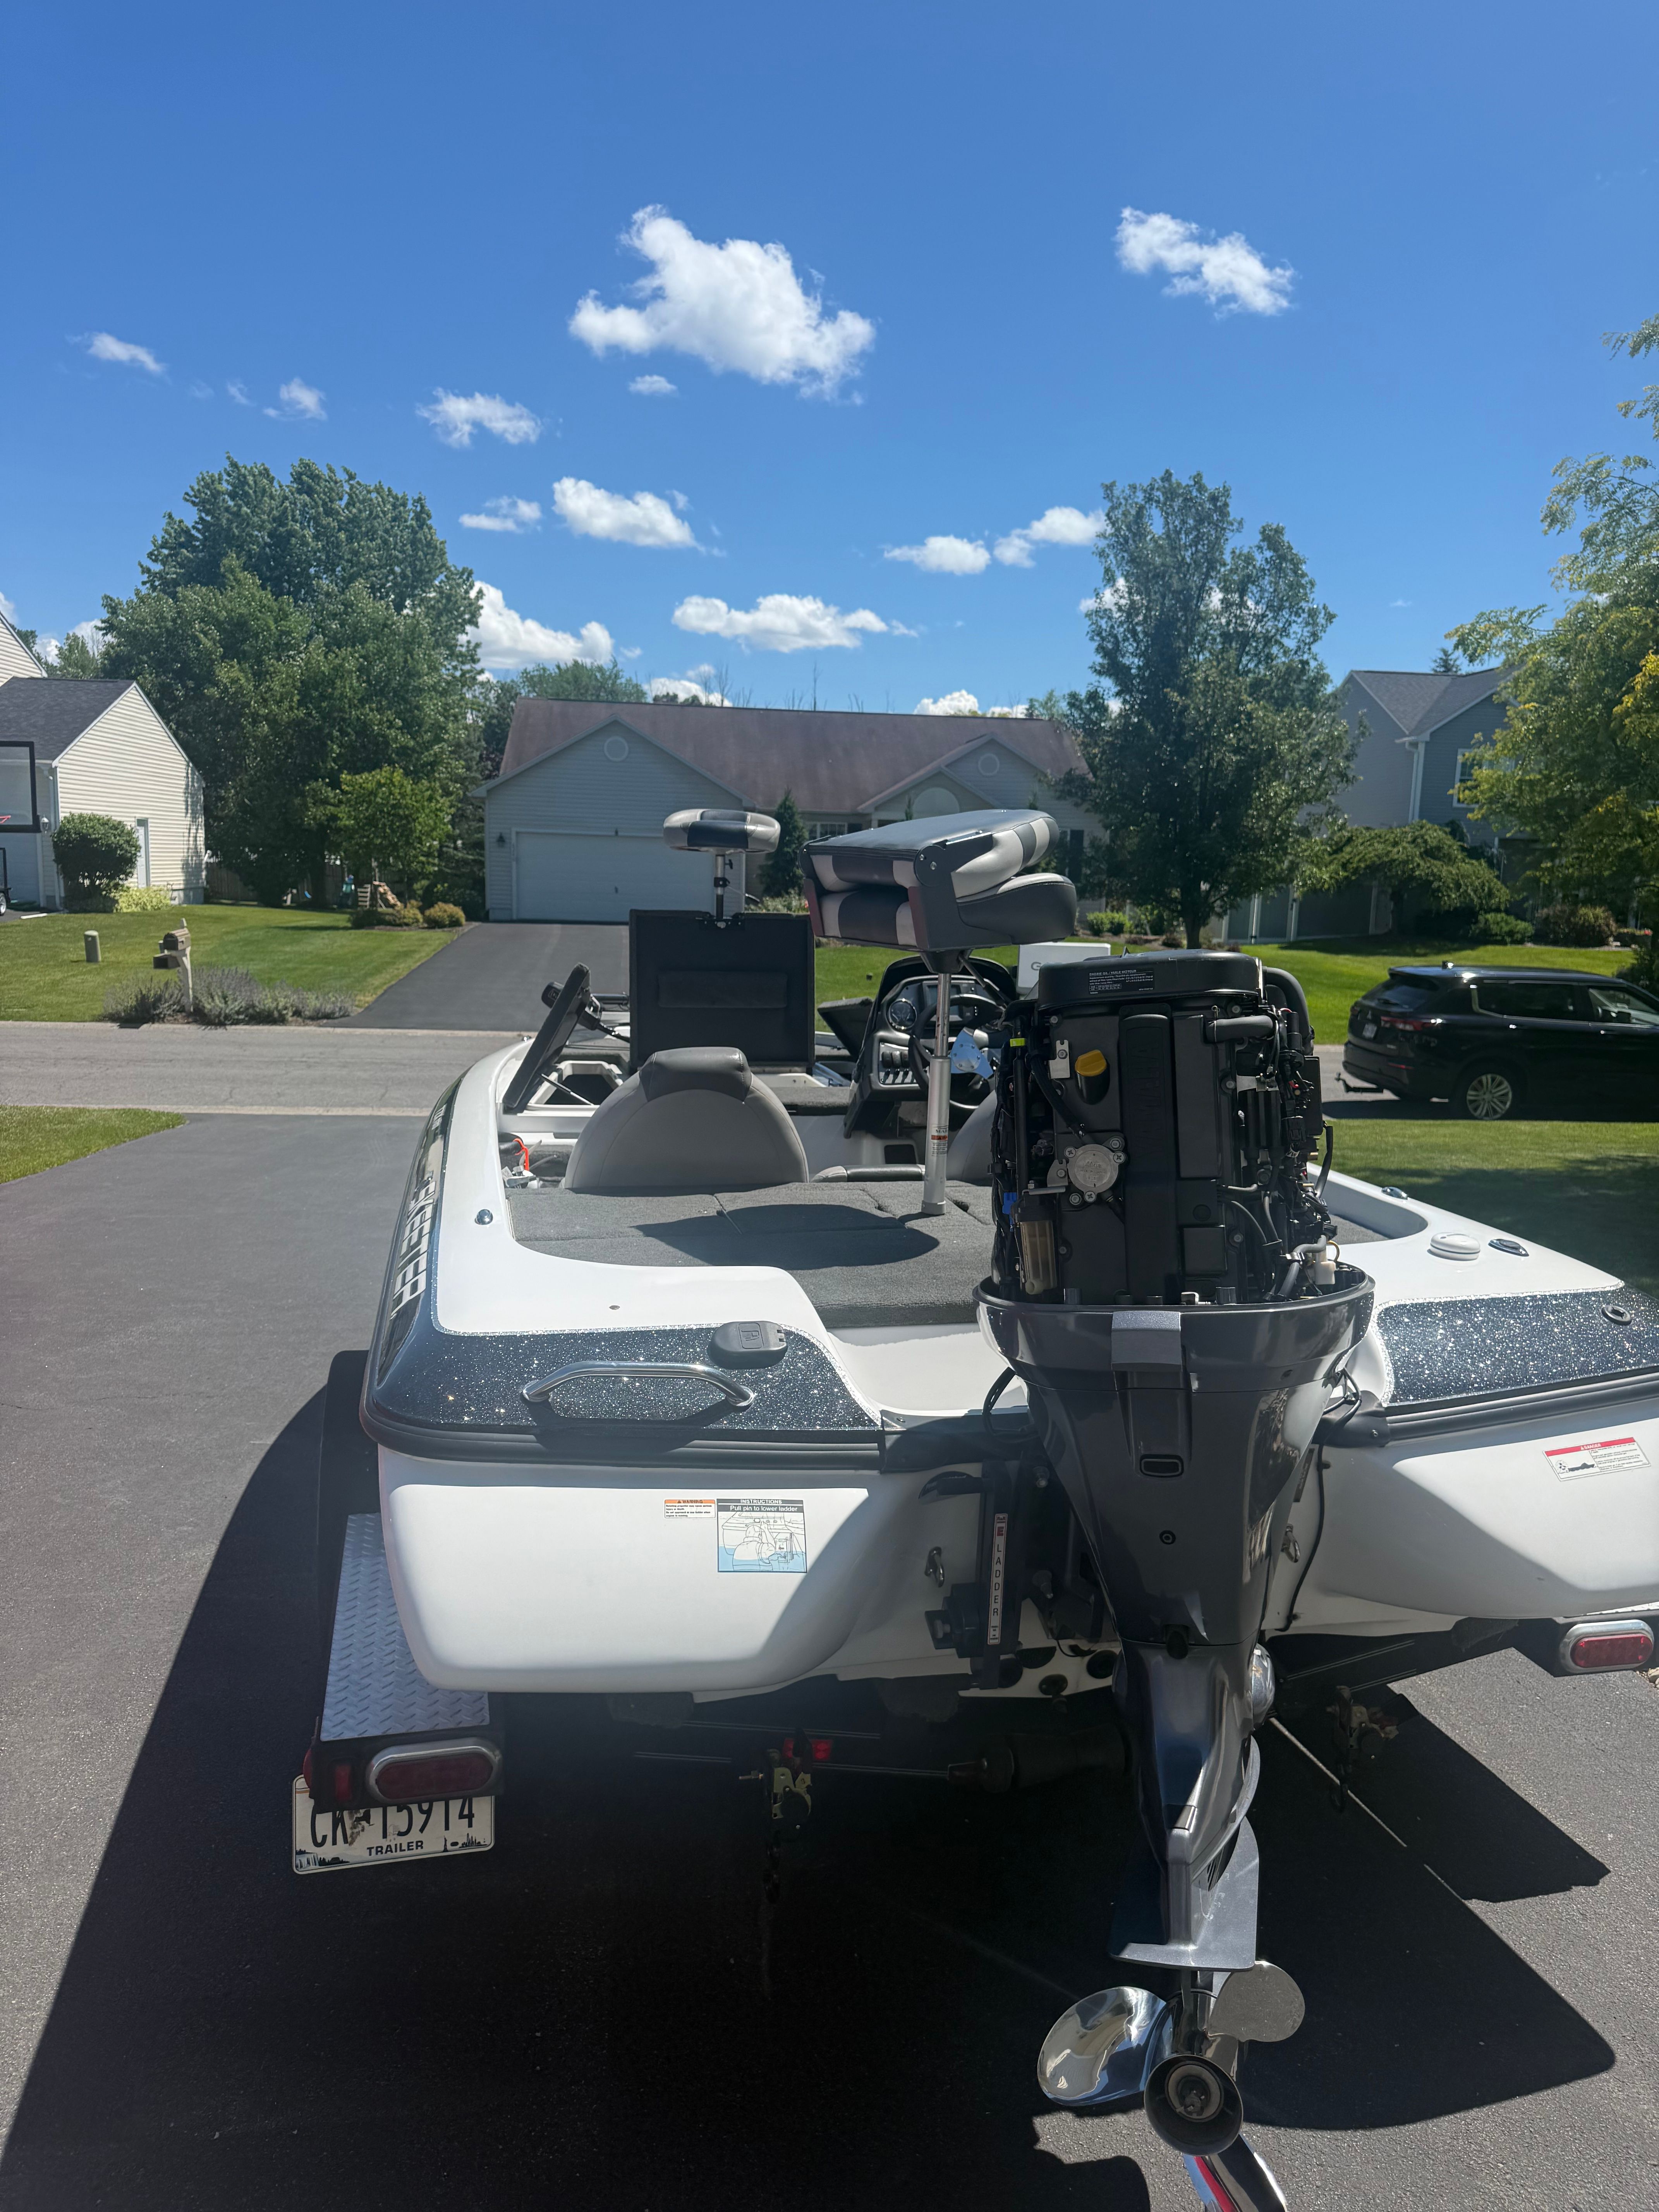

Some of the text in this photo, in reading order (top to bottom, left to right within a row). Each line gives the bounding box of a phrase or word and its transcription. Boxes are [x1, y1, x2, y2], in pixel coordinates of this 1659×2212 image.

[390, 1181, 436, 1319] SKEETER
[993, 1544, 1002, 1616] LADDER
[366, 1840, 424, 1856] TRAILER
